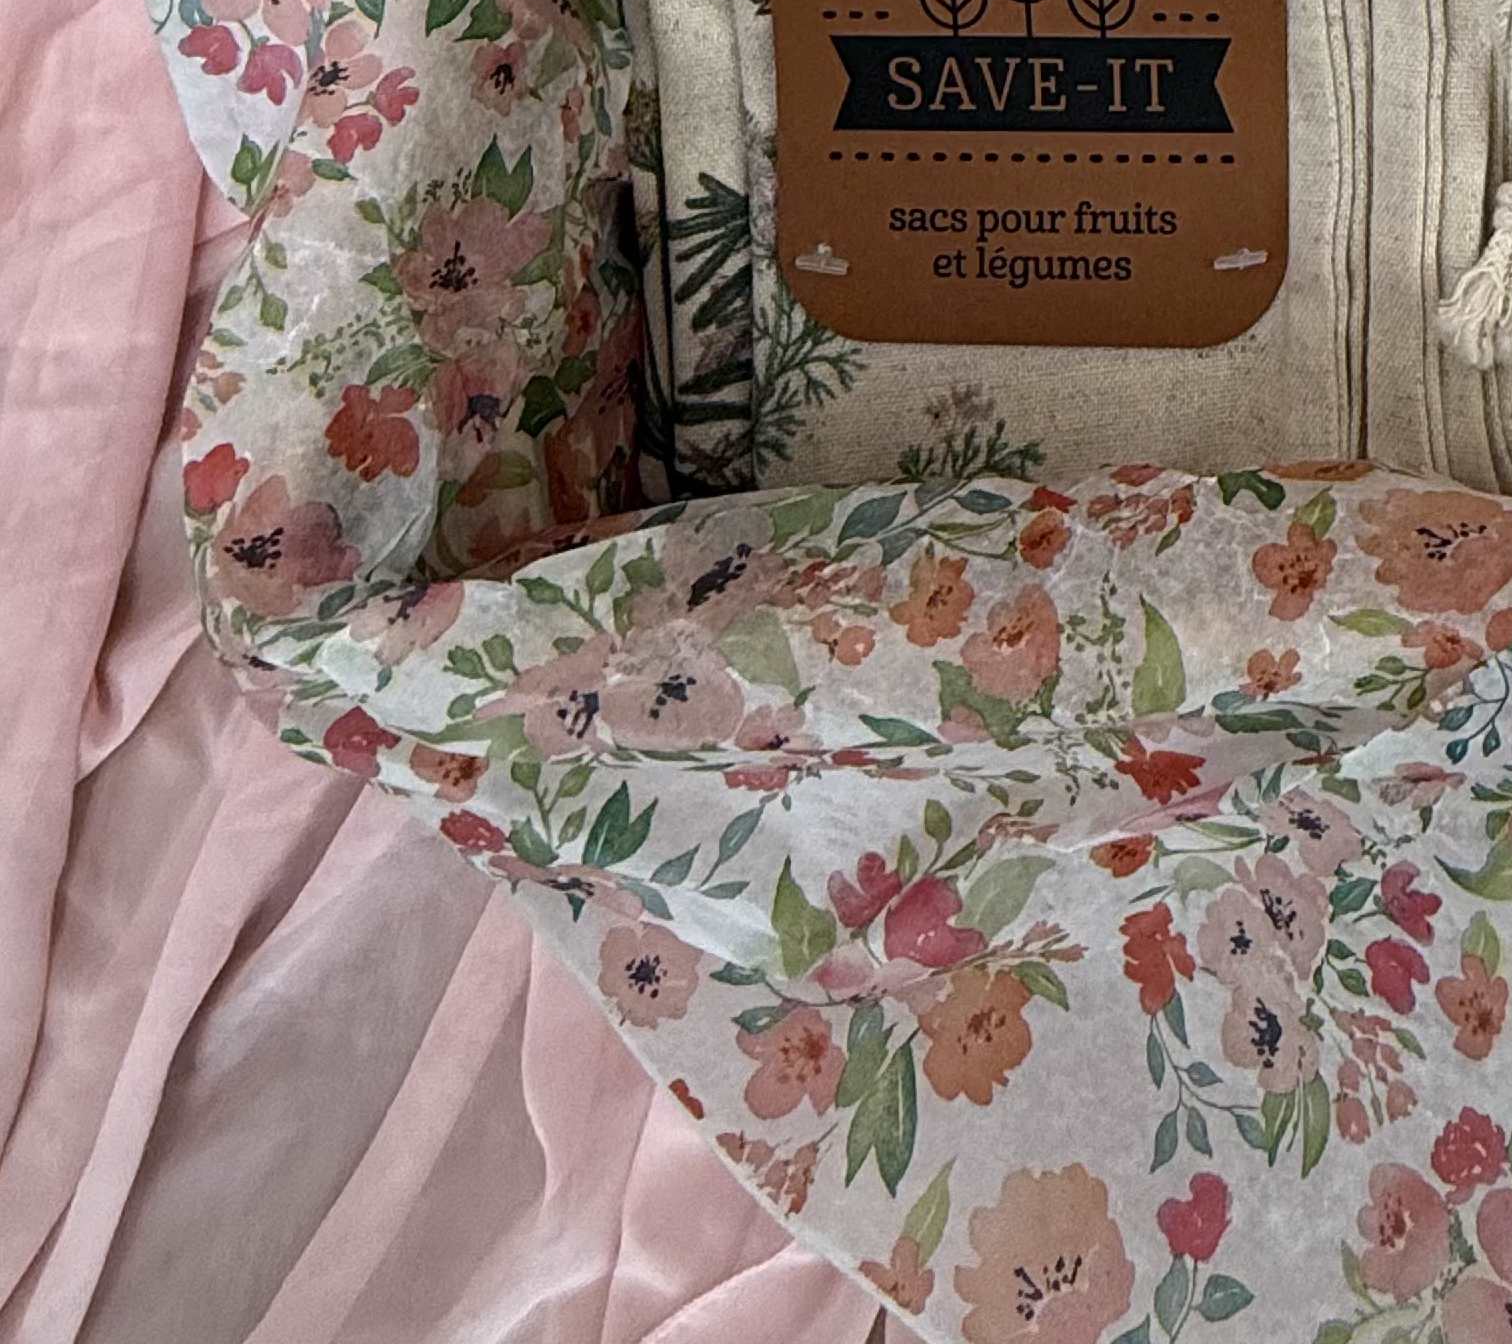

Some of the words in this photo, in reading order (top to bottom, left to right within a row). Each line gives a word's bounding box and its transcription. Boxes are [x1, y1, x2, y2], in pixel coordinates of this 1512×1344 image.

[886, 56, 1176, 113] SAVE-IT
[888, 205, 968, 233] sacs
[976, 207, 1066, 243] pour
[1072, 201, 1178, 236] fruits
[932, 250, 967, 280] et
[975, 246, 1133, 290] légumes
